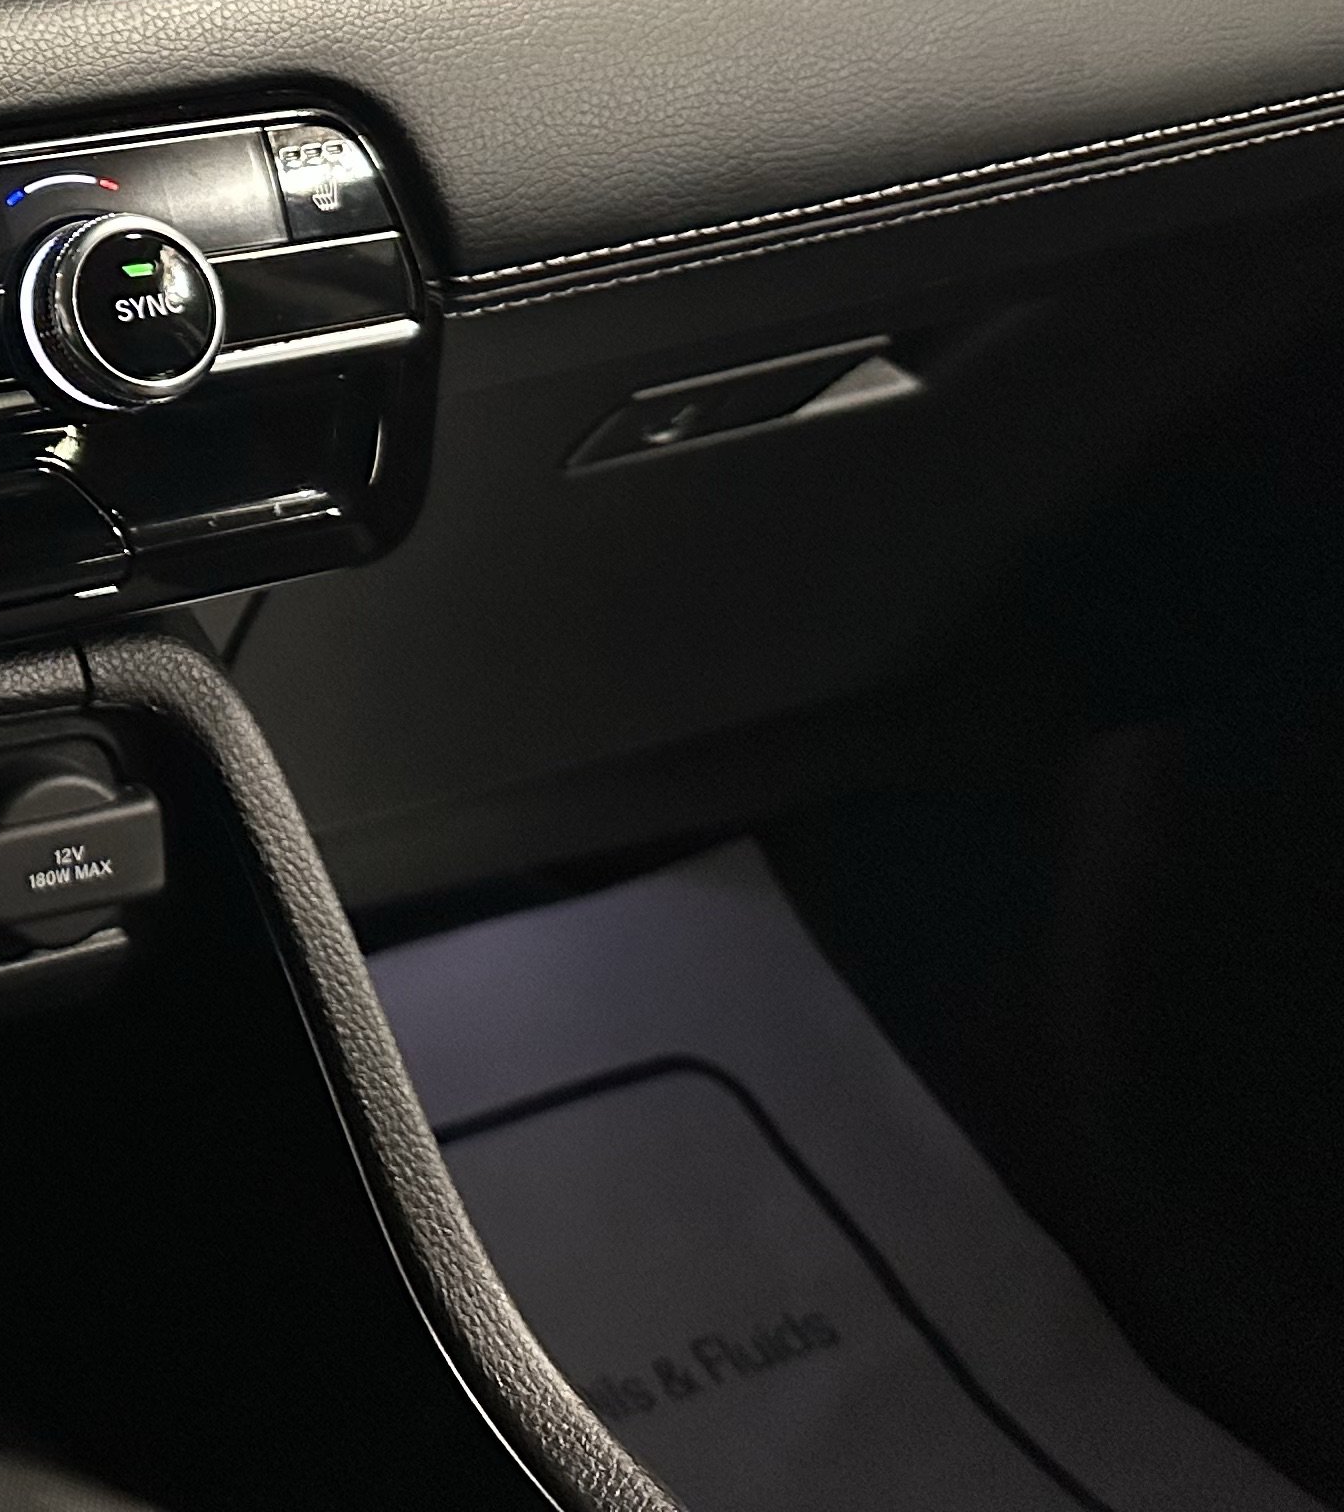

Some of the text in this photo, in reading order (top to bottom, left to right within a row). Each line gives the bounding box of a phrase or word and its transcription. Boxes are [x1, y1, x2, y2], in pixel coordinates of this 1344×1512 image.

[54, 845, 85, 865] 12V
[28, 859, 113, 889] 180W MAX
